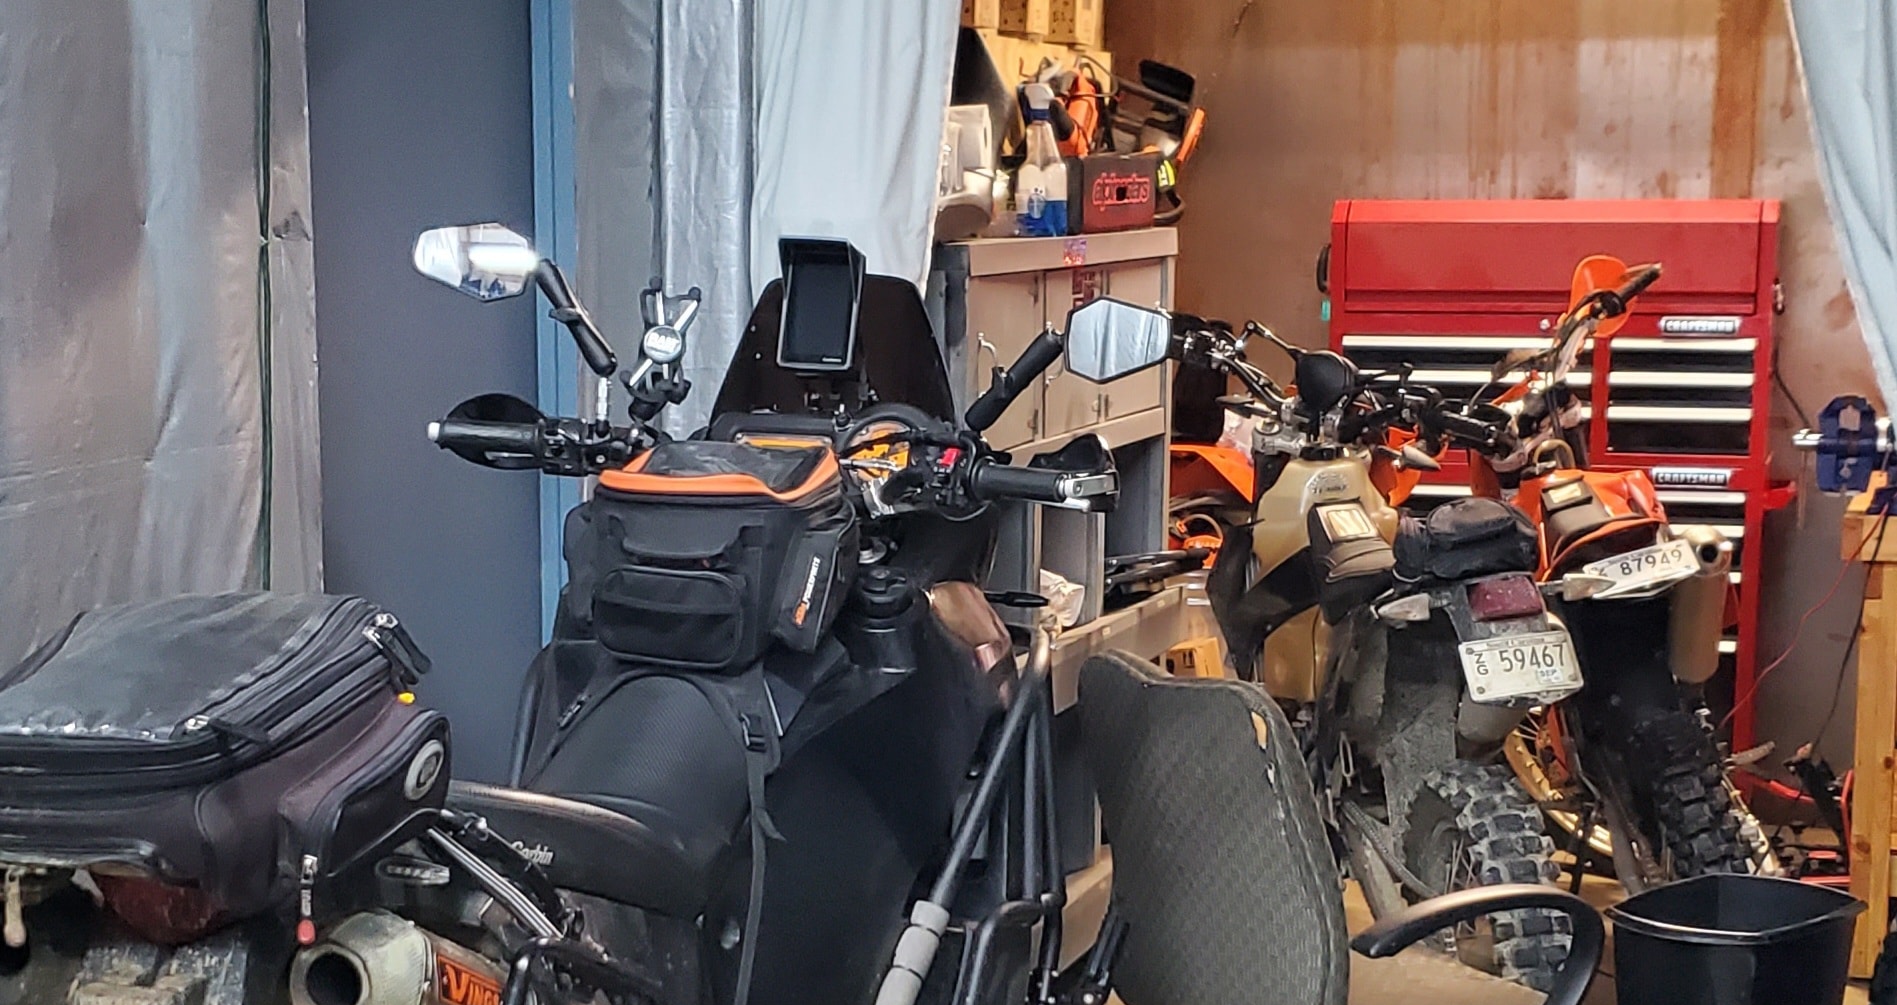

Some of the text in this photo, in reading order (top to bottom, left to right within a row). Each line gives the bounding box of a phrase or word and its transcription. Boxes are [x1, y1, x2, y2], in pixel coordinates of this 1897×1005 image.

[1657, 472, 1725, 485] CRAFTSMAN
[1619, 549, 1683, 576] 87949
[1498, 644, 1565, 673] 59467
